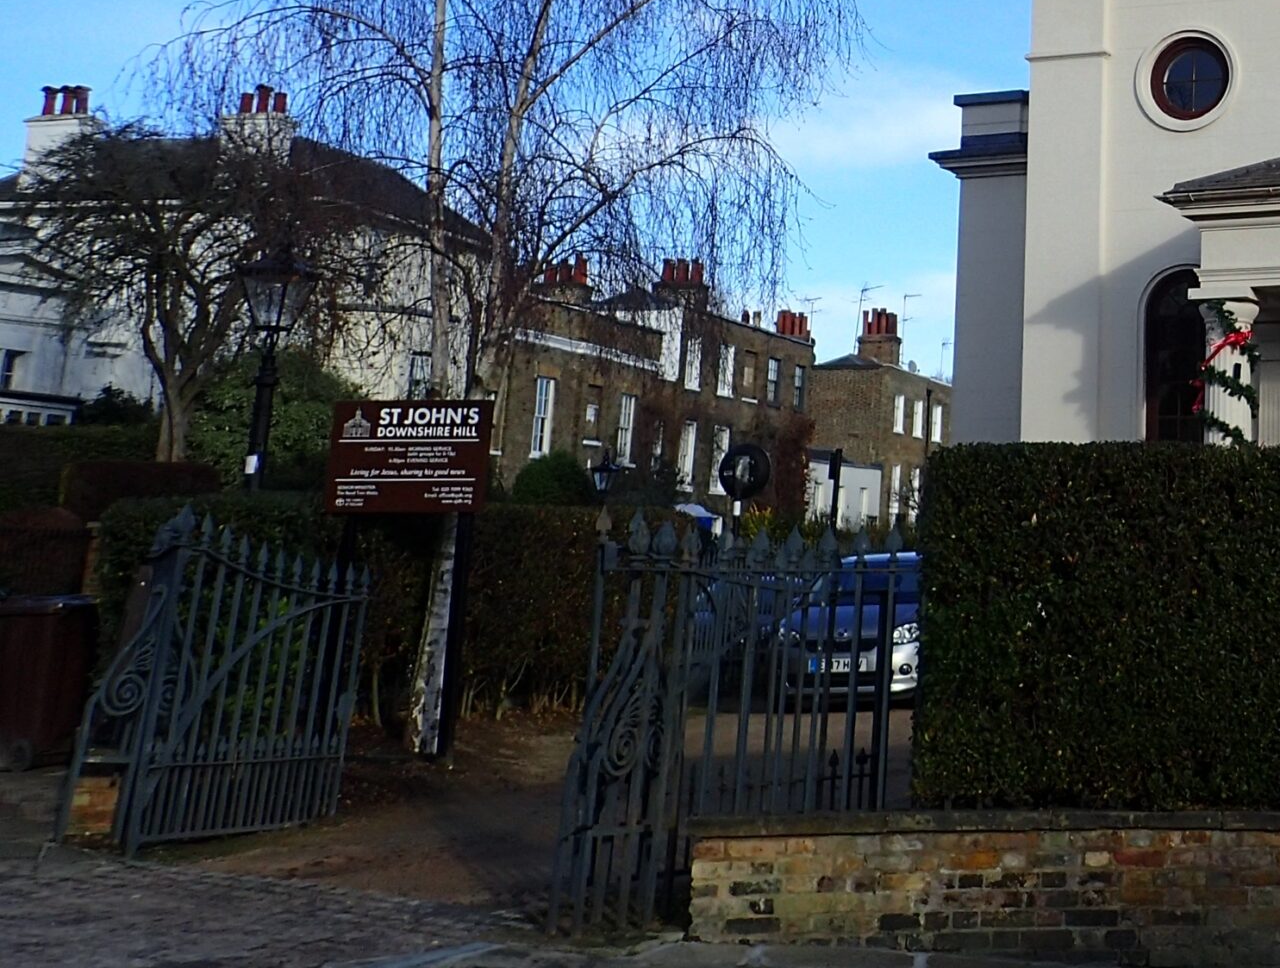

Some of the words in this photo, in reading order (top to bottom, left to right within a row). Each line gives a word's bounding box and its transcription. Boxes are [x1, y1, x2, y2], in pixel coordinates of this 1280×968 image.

[378, 408, 402, 425] ST
[404, 407, 480, 425] JOHN'S
[377, 426, 450, 437] DOWNSHIRE
[453, 426, 478, 437] HILL
